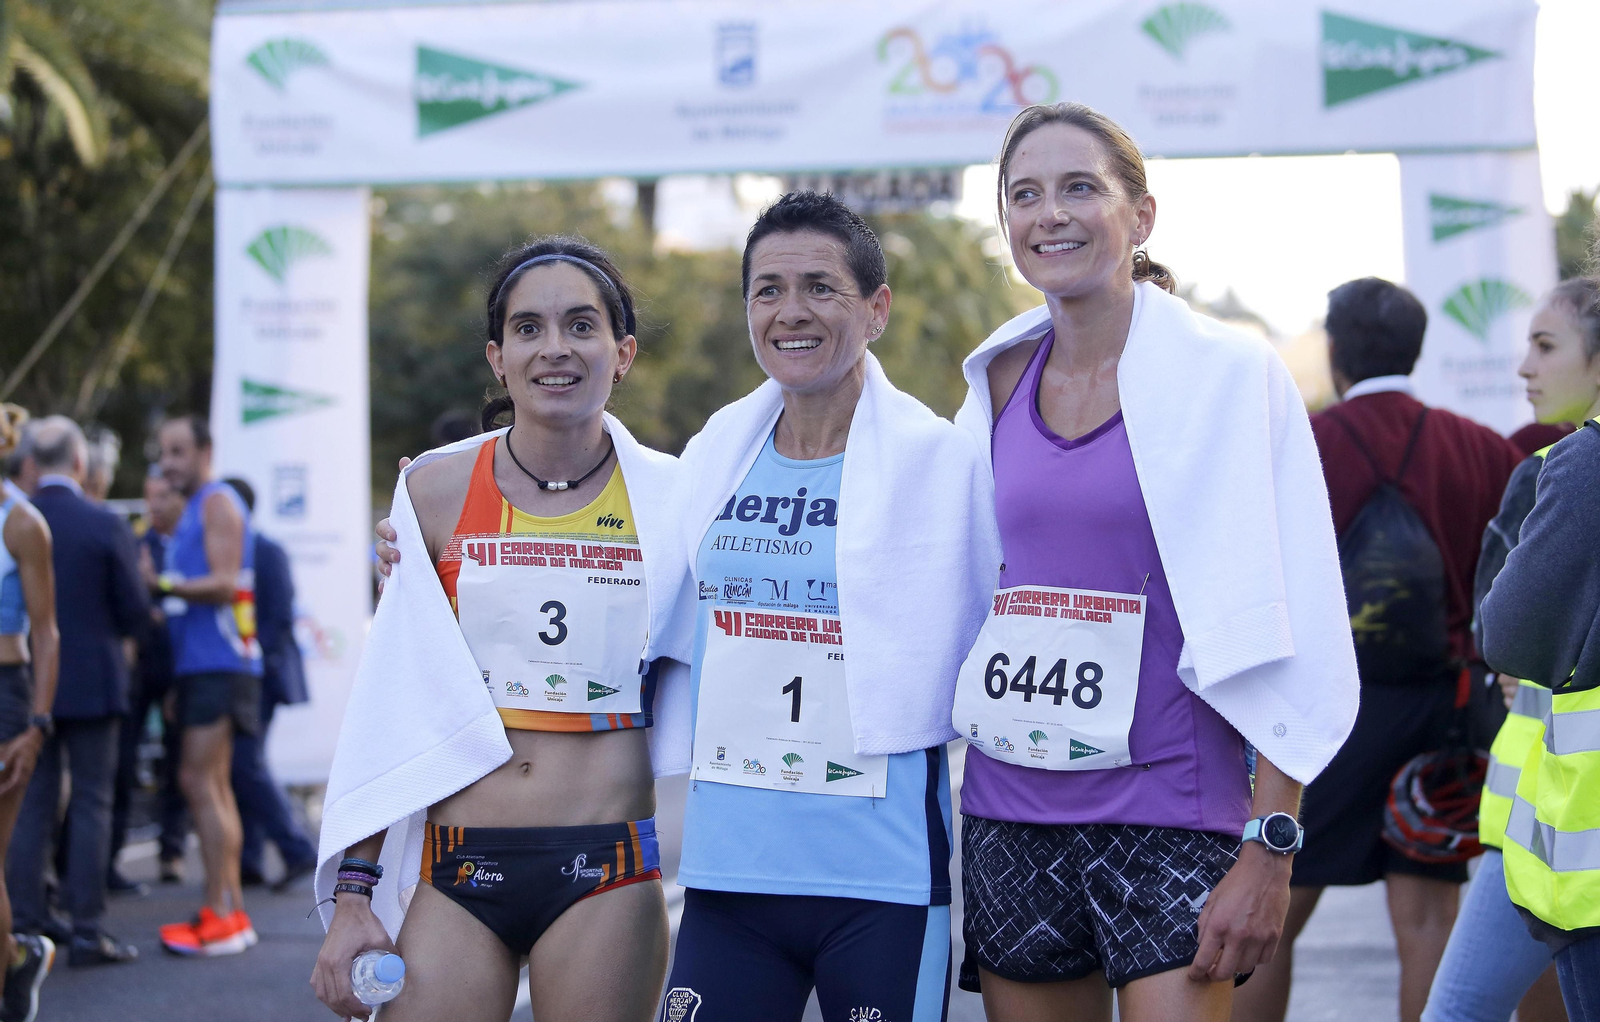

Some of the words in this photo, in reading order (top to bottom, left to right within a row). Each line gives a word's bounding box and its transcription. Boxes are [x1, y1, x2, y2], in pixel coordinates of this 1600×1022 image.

[500, 541, 578, 557] CARRERA
[710, 534, 813, 556] ATLETISMO
[500, 555, 547, 567] CIUDAD
[550, 557, 566, 568] DE
[569, 558, 623, 571] MÁLAGA
[587, 576, 641, 587] FEDERADO
[1006, 604, 1042, 617] CIUDAD
[1044, 606, 1058, 618] DE
[1009, 590, 1070, 607] CARRERA
[1073, 594, 1141, 614] URBANA
[538, 600, 568, 646] 3
[745, 612, 818, 632] CARRERA
[745, 627, 788, 641] CIUDAD
[791, 631, 807, 642] DE
[984, 652, 1104, 710] 6448
[782, 676, 803, 723] 1
[473, 866, 505, 881] Álora
